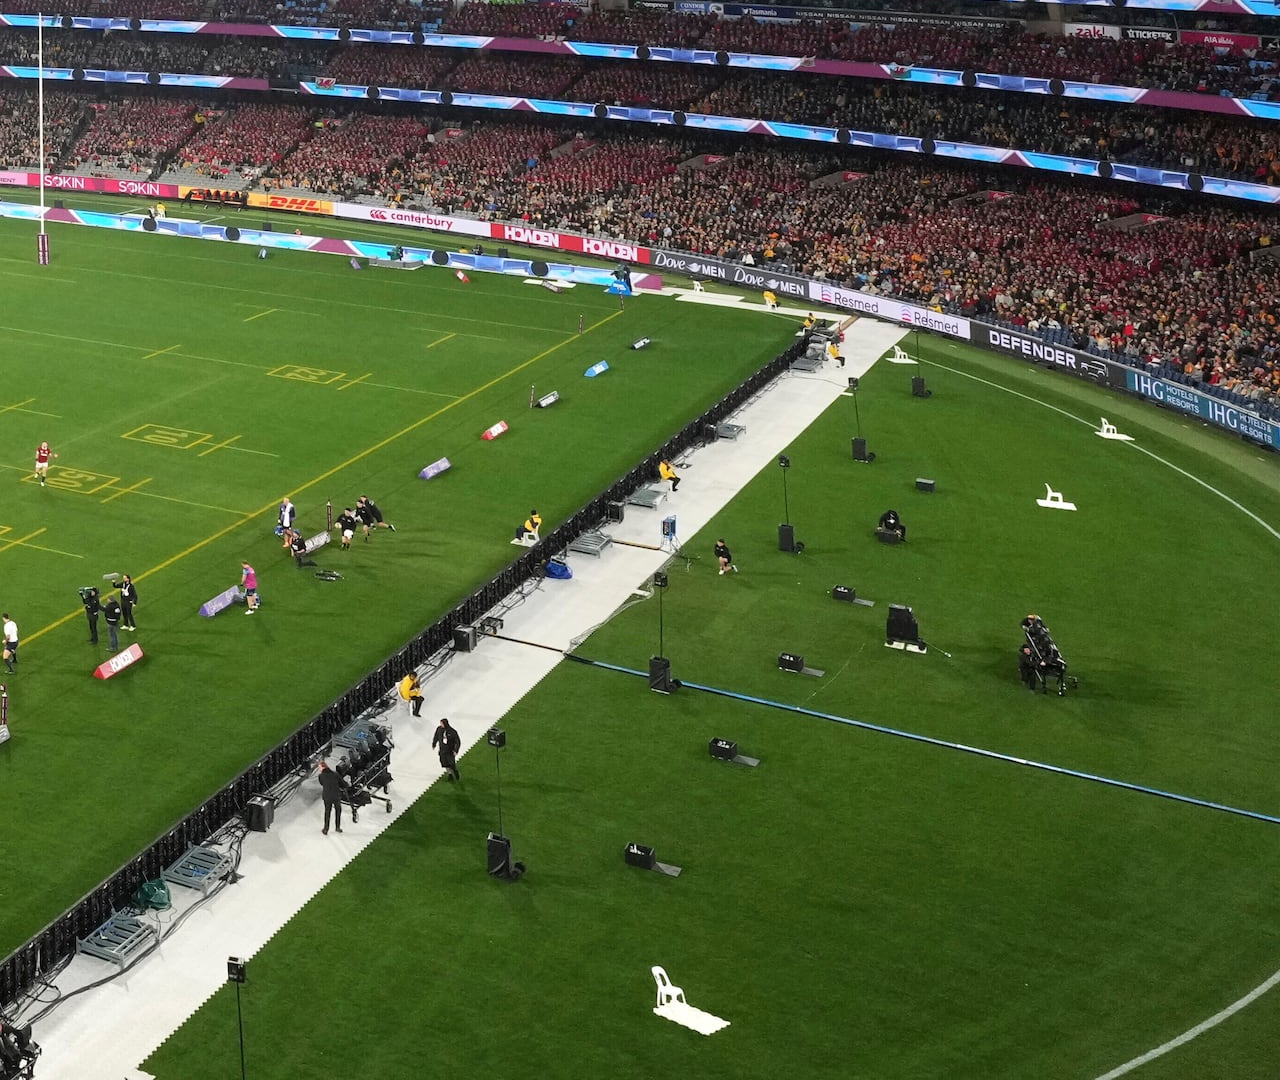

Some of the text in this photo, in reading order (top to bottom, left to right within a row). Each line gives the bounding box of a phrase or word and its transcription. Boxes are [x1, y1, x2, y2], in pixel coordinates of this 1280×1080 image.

[748, 7, 777, 16] Tasmania
[1136, 30, 1172, 41] TICKETEK
[44, 175, 84, 189] SOKIN
[118, 181, 160, 195] SOKIN
[269, 196, 320, 212] DHL
[391, 211, 453, 230] canterbury
[504, 226, 560, 248] HOWDEN
[583, 238, 638, 261] HOWDEN
[655, 251, 726, 278] Dove MEN
[734, 268, 805, 295] Dove MEN
[834, 292, 879, 313] Resmed
[914, 315, 959, 335] Resmed
[990, 331, 1076, 369] DEFENDER
[1134, 373, 1164, 400] IHG
[1166, 385, 1192, 401] HOTELS
[1167, 397, 1200, 414] RESORTS
[1208, 400, 1237, 428] IHG
[1240, 413, 1265, 429] HOTELS
[143, 430, 189, 444] 10
[1240, 424, 1273, 443] RESORTS
[46, 470, 96, 488] 50
